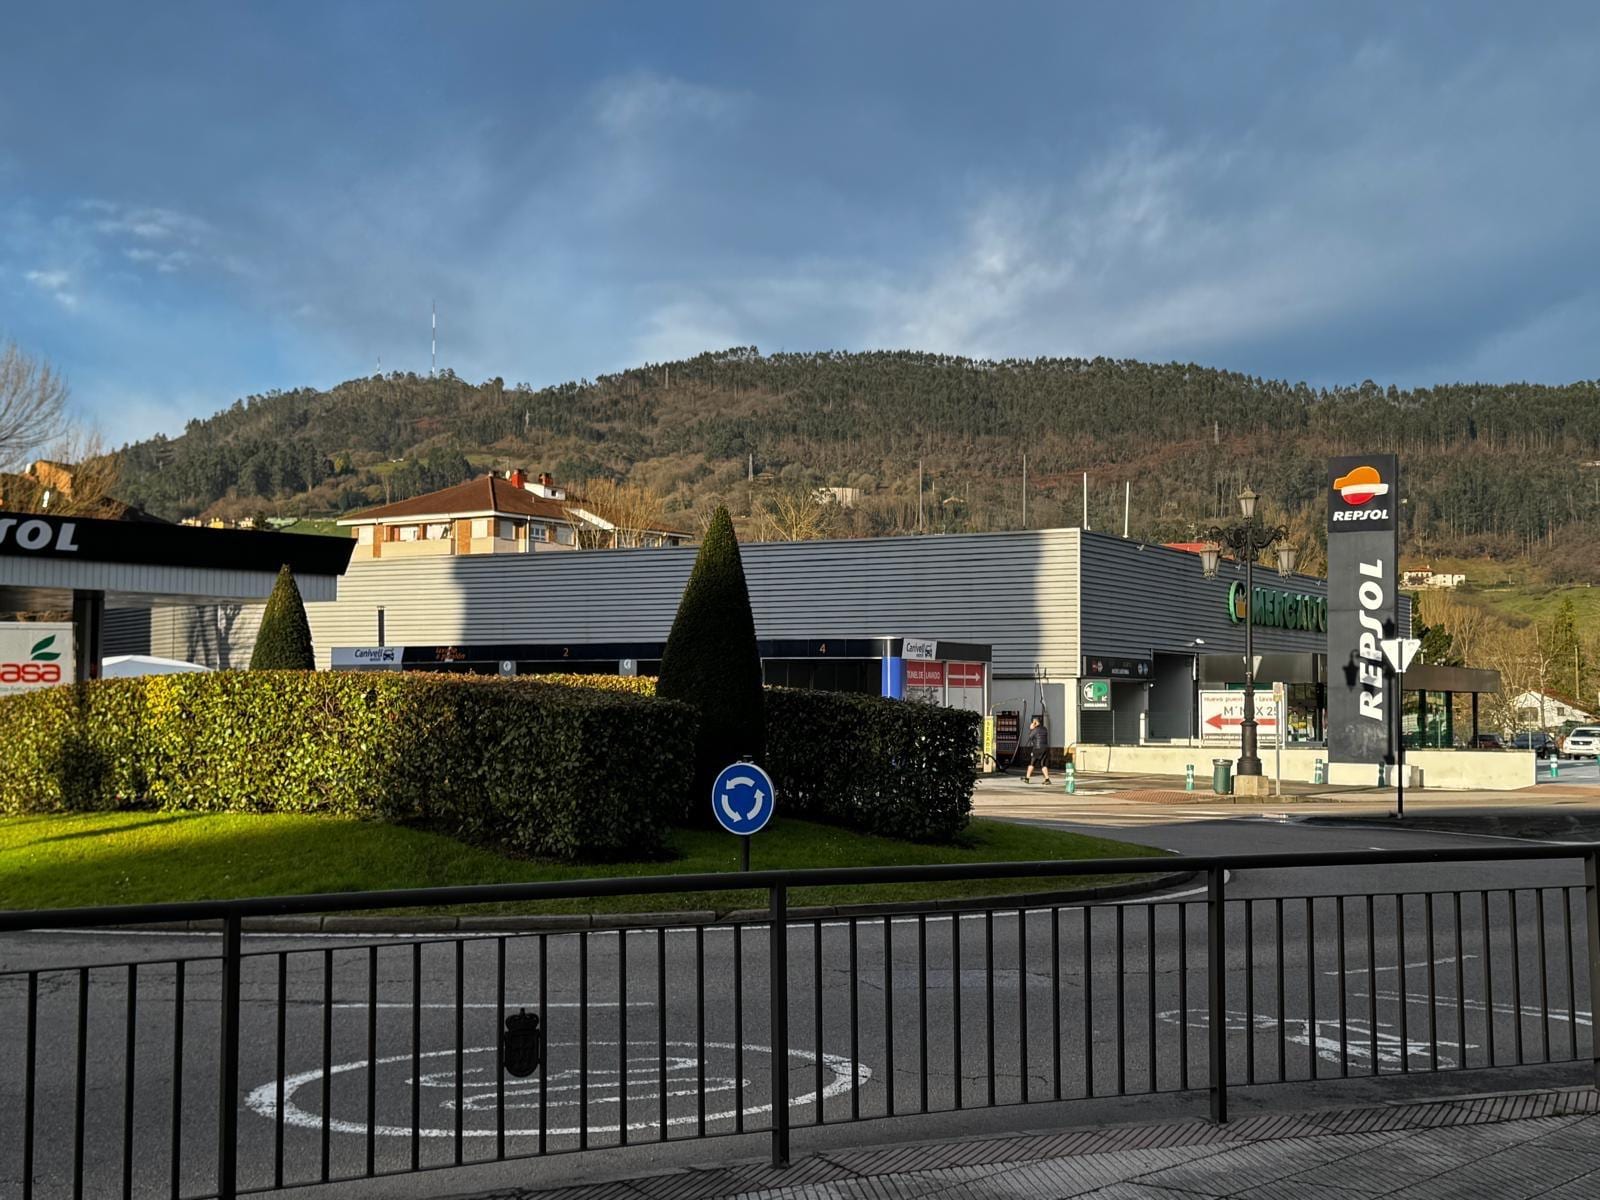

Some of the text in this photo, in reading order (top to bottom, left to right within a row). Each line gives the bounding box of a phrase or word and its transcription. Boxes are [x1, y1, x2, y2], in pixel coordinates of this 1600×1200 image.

[1333, 509, 1389, 522] REPSOL
[1252, 587, 1328, 633] MERCADO
[1358, 559, 1384, 721] REPSOL
[563, 647, 569, 657] 2
[819, 643, 827, 654] 4
[0, 664, 61, 683] asa
